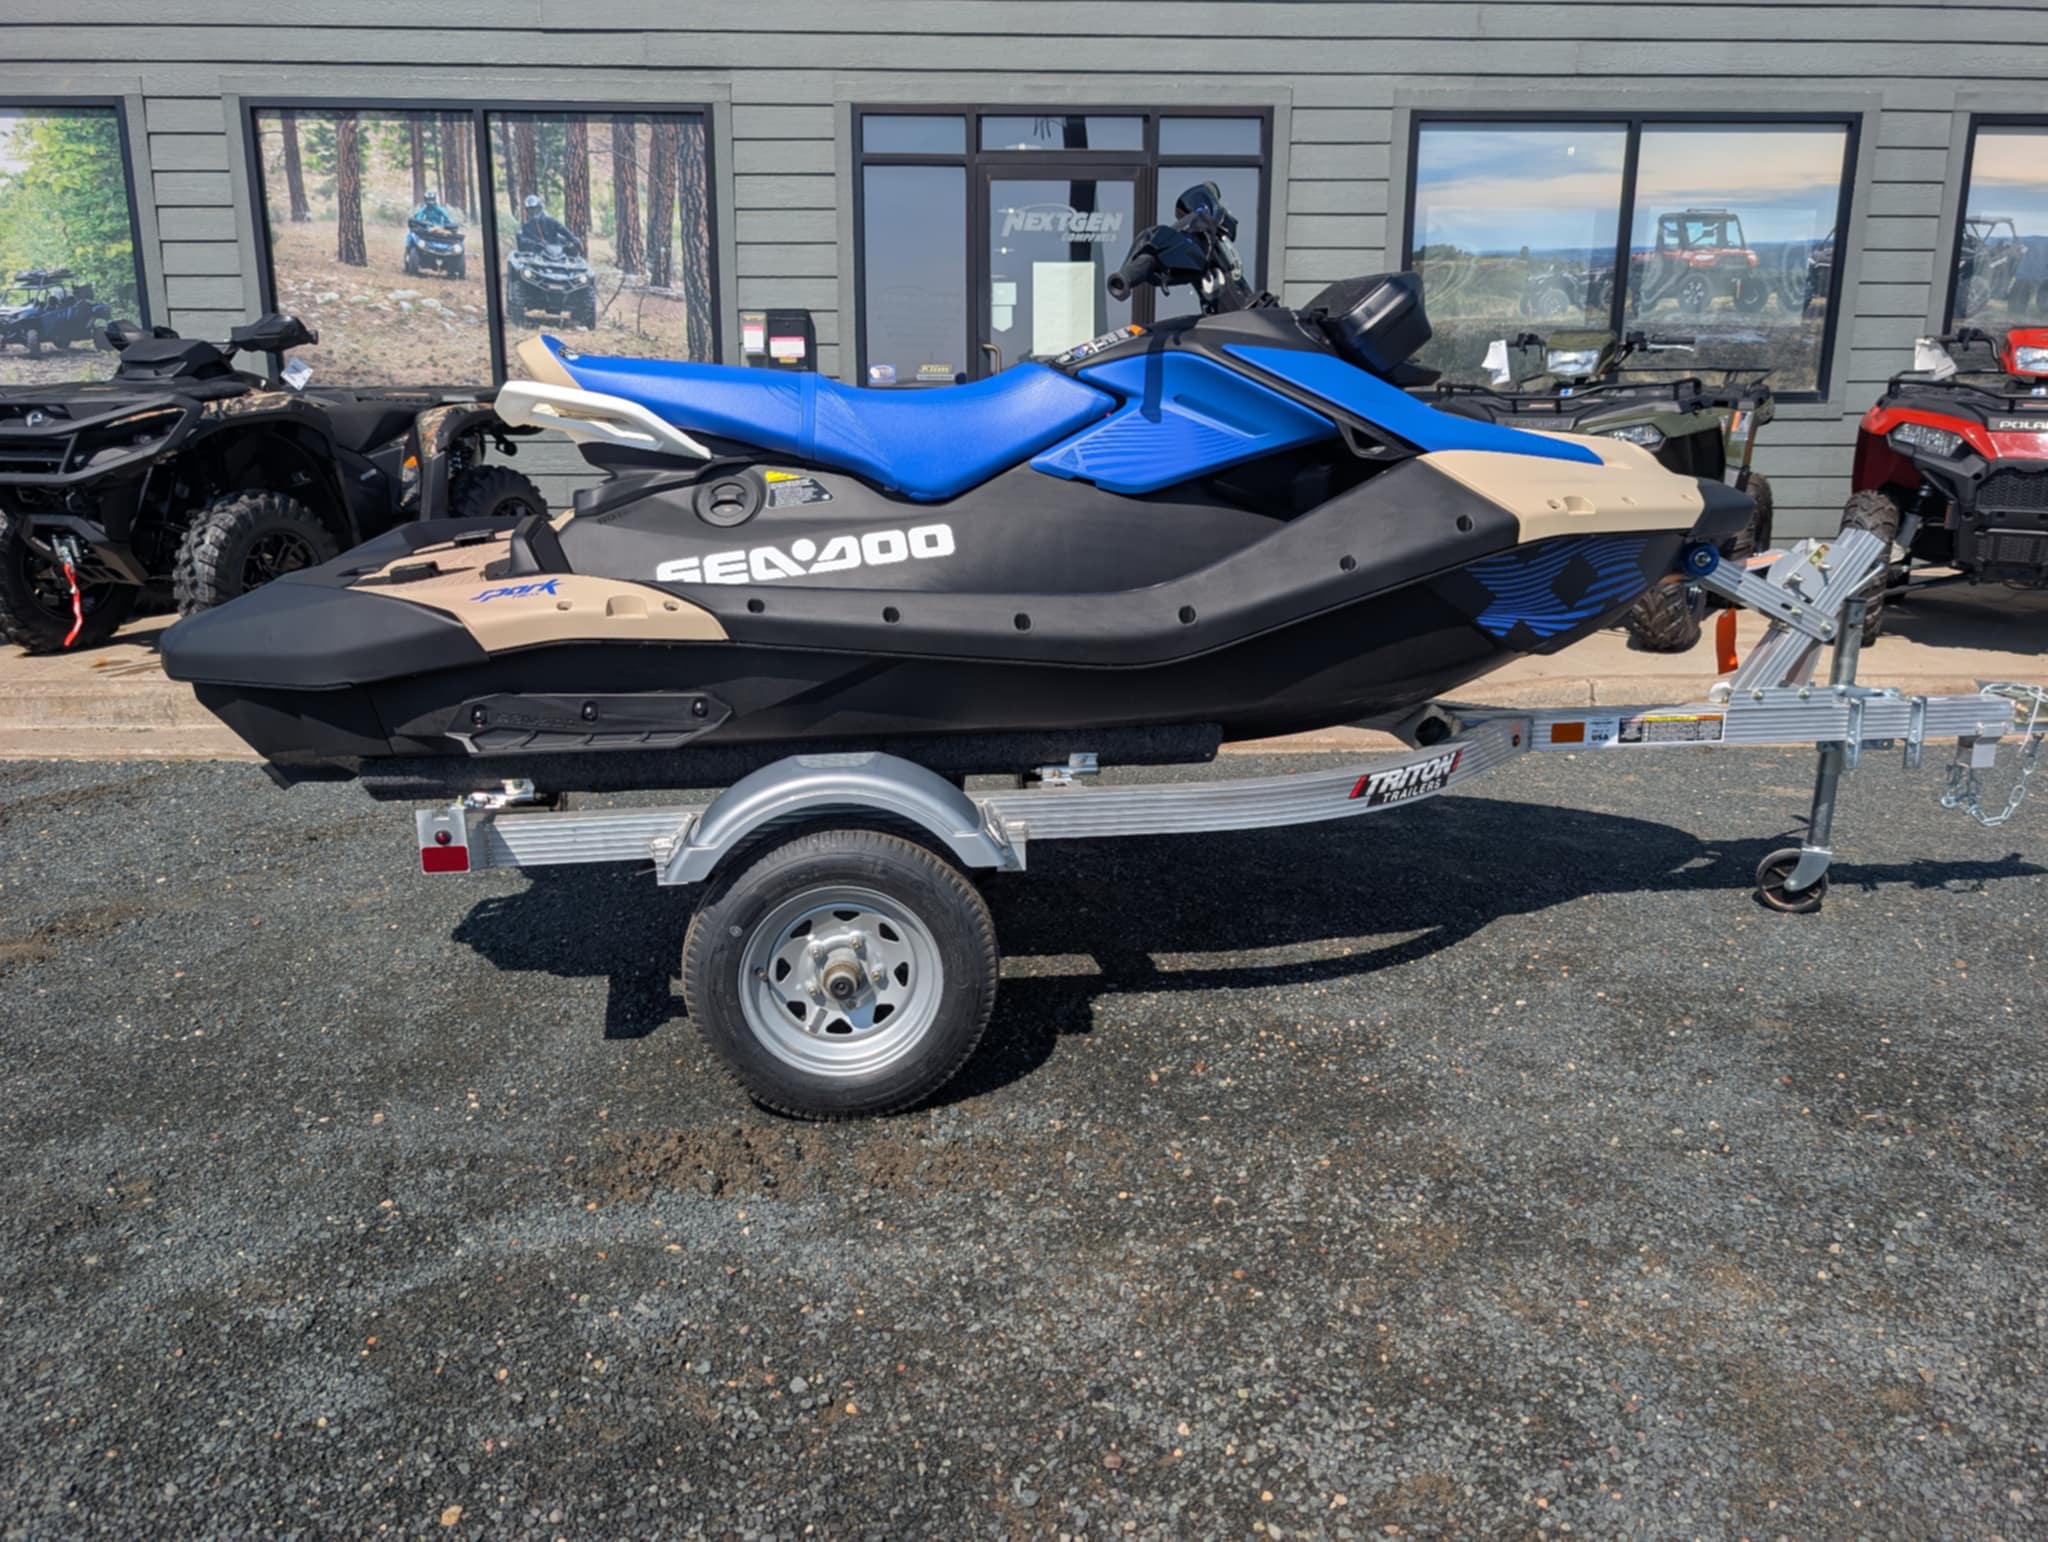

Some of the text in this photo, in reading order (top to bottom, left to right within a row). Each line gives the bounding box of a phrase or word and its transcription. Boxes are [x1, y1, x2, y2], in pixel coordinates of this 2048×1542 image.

[1001, 210, 1123, 237] NEXTGEN
[1999, 420, 2048, 430] POLA
[1365, 751, 1457, 797] TRITON
[1383, 778, 1441, 803] TRAILERS
